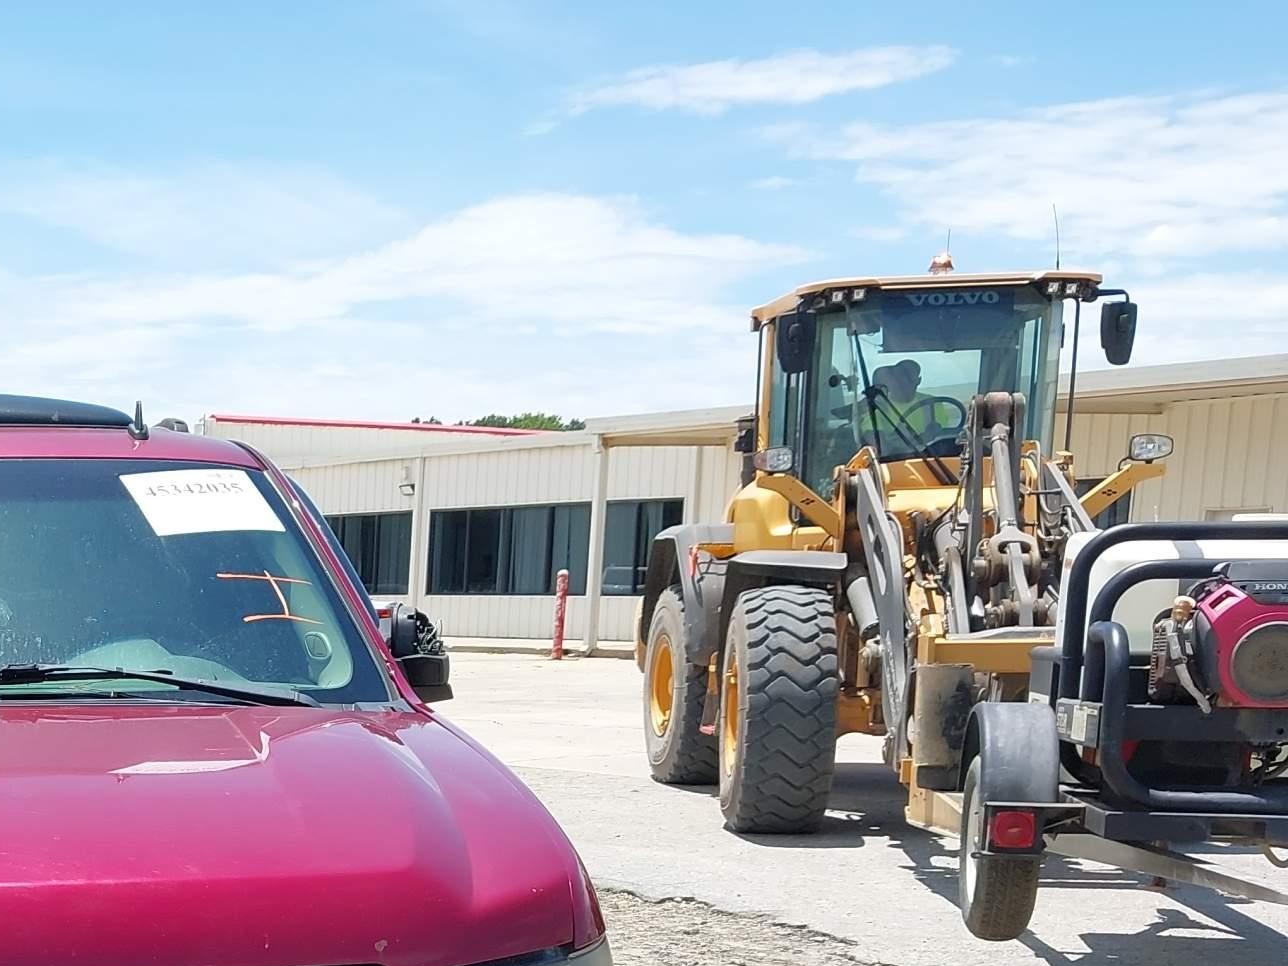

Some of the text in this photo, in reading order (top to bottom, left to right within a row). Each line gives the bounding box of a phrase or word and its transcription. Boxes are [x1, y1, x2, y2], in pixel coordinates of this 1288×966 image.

[905, 290, 999, 306] VOLVO
[145, 482, 244, 497] 45342035
[1254, 583, 1288, 591] HON
